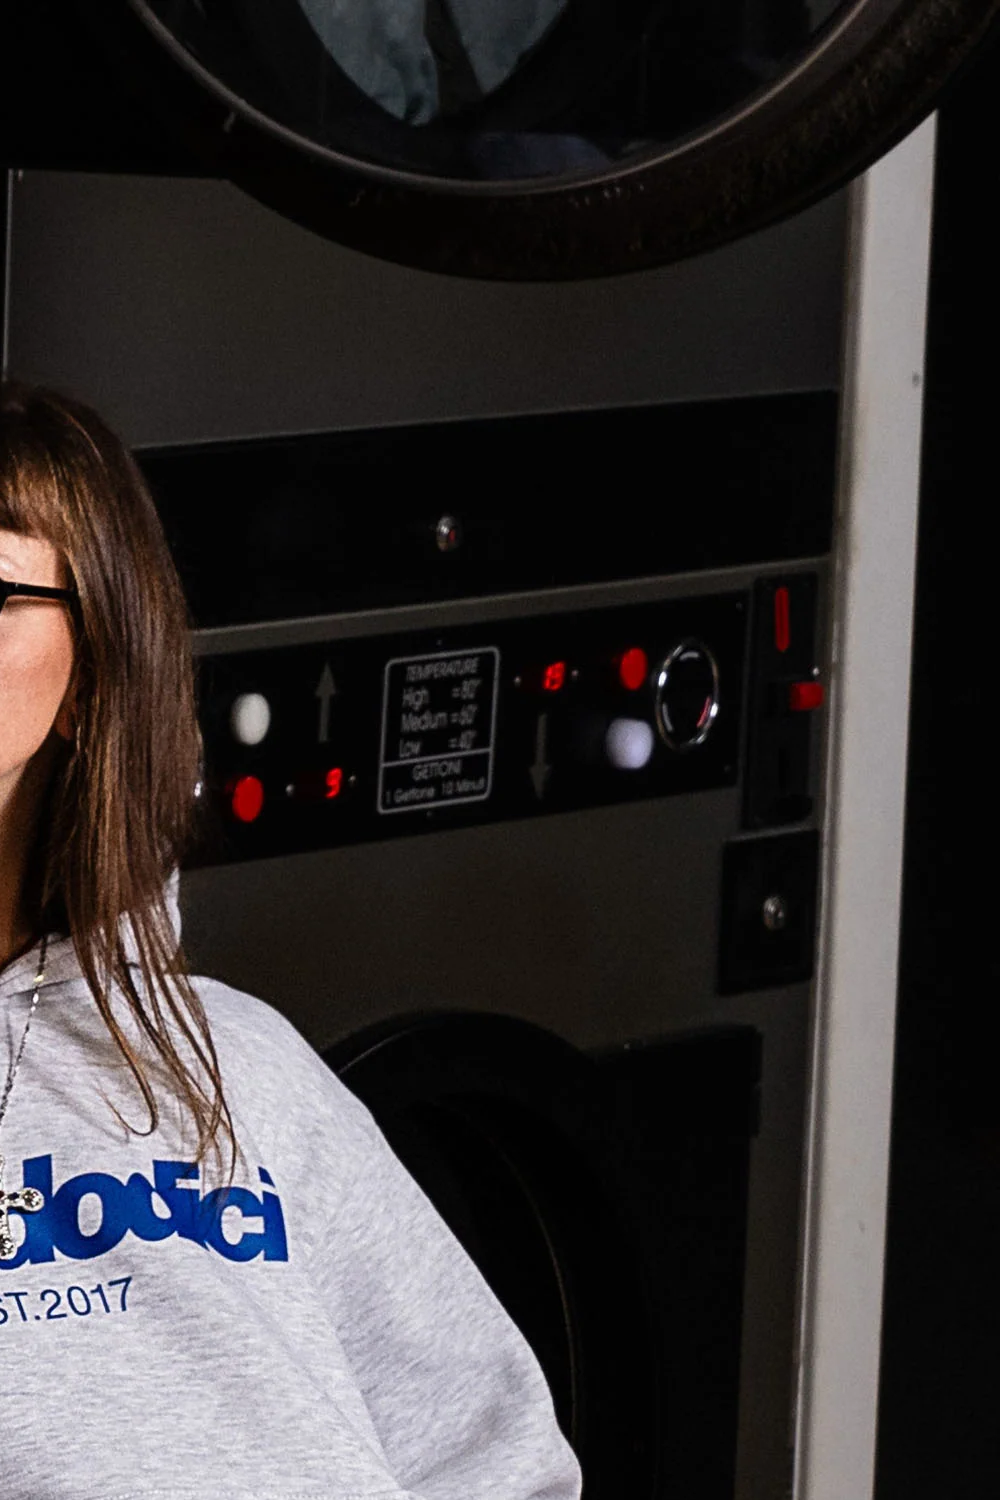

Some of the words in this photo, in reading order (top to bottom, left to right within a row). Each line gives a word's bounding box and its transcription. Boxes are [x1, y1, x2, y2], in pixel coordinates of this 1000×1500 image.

[405, 657, 480, 682] TEMPERATURE
[402, 686, 431, 711] High
[398, 738, 423, 758] Low
